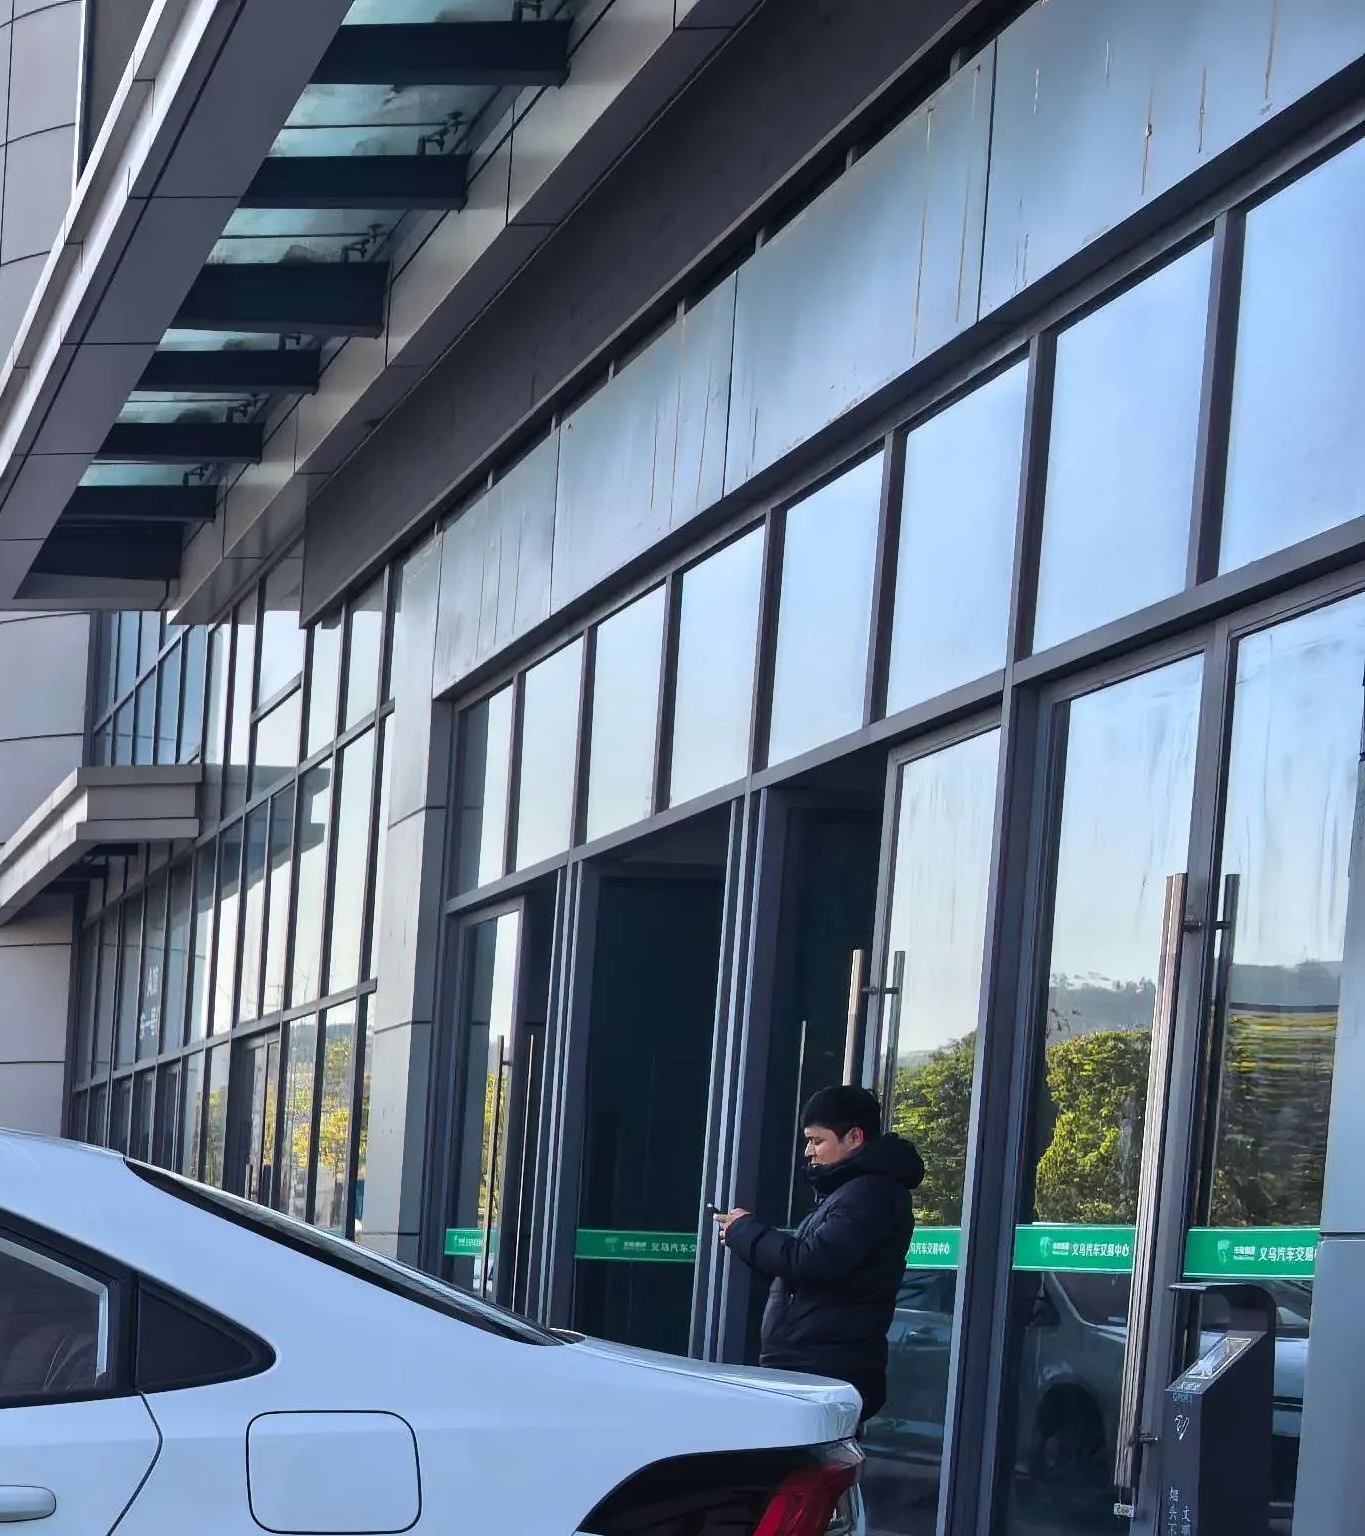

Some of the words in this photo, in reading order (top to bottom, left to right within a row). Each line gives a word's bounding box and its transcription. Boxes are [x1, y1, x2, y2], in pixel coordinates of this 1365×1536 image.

[1258, 1246, 1317, 1262] 义乌汽车交易
